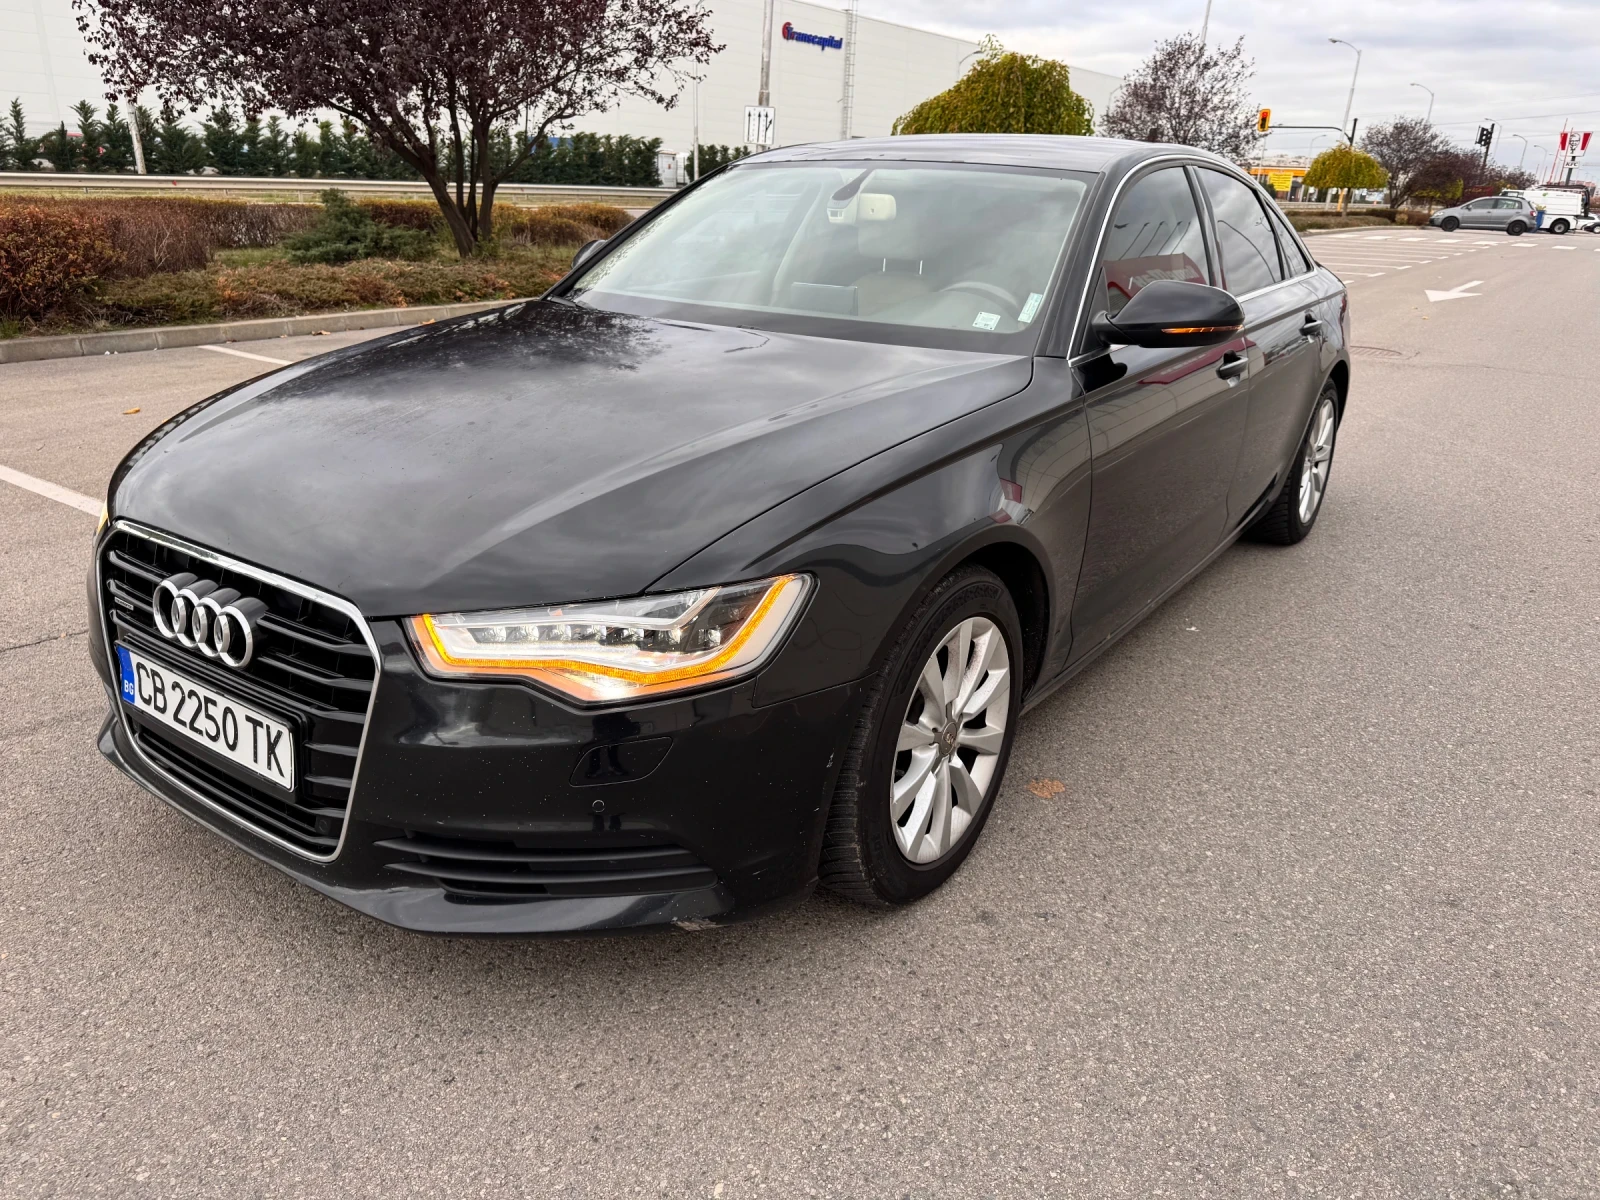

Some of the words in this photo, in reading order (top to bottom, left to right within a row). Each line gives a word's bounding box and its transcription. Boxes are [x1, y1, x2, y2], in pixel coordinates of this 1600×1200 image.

[124, 679, 135, 696] BG
[136, 661, 168, 715] CB
[171, 681, 239, 752] 2250
[245, 714, 285, 778] TK
